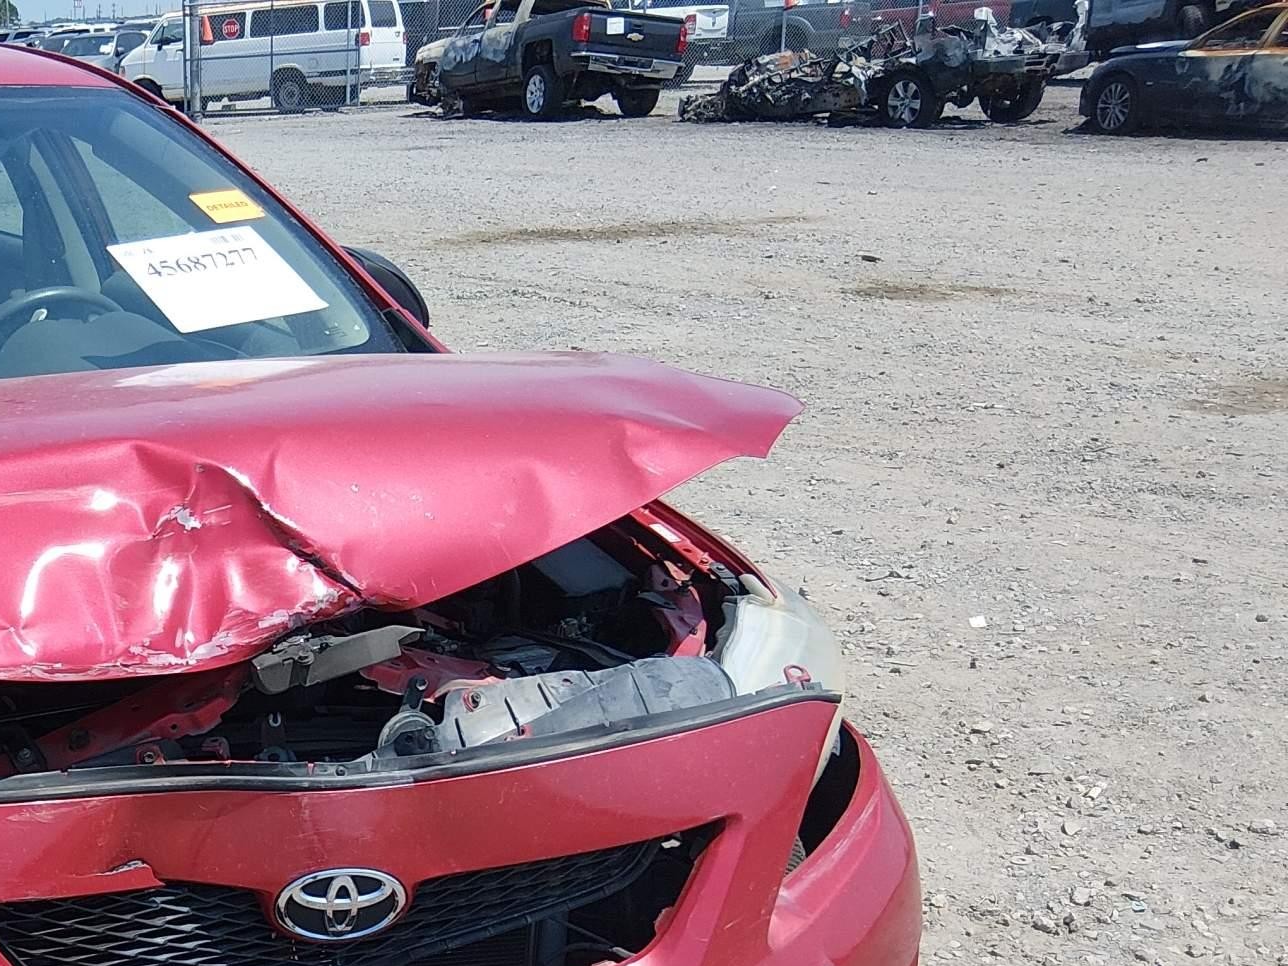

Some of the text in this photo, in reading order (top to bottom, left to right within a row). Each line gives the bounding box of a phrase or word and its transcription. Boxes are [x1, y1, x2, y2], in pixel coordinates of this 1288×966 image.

[224, 24, 238, 33] STOP
[206, 200, 249, 212] DETAILED
[147, 248, 258, 278] 45687277
